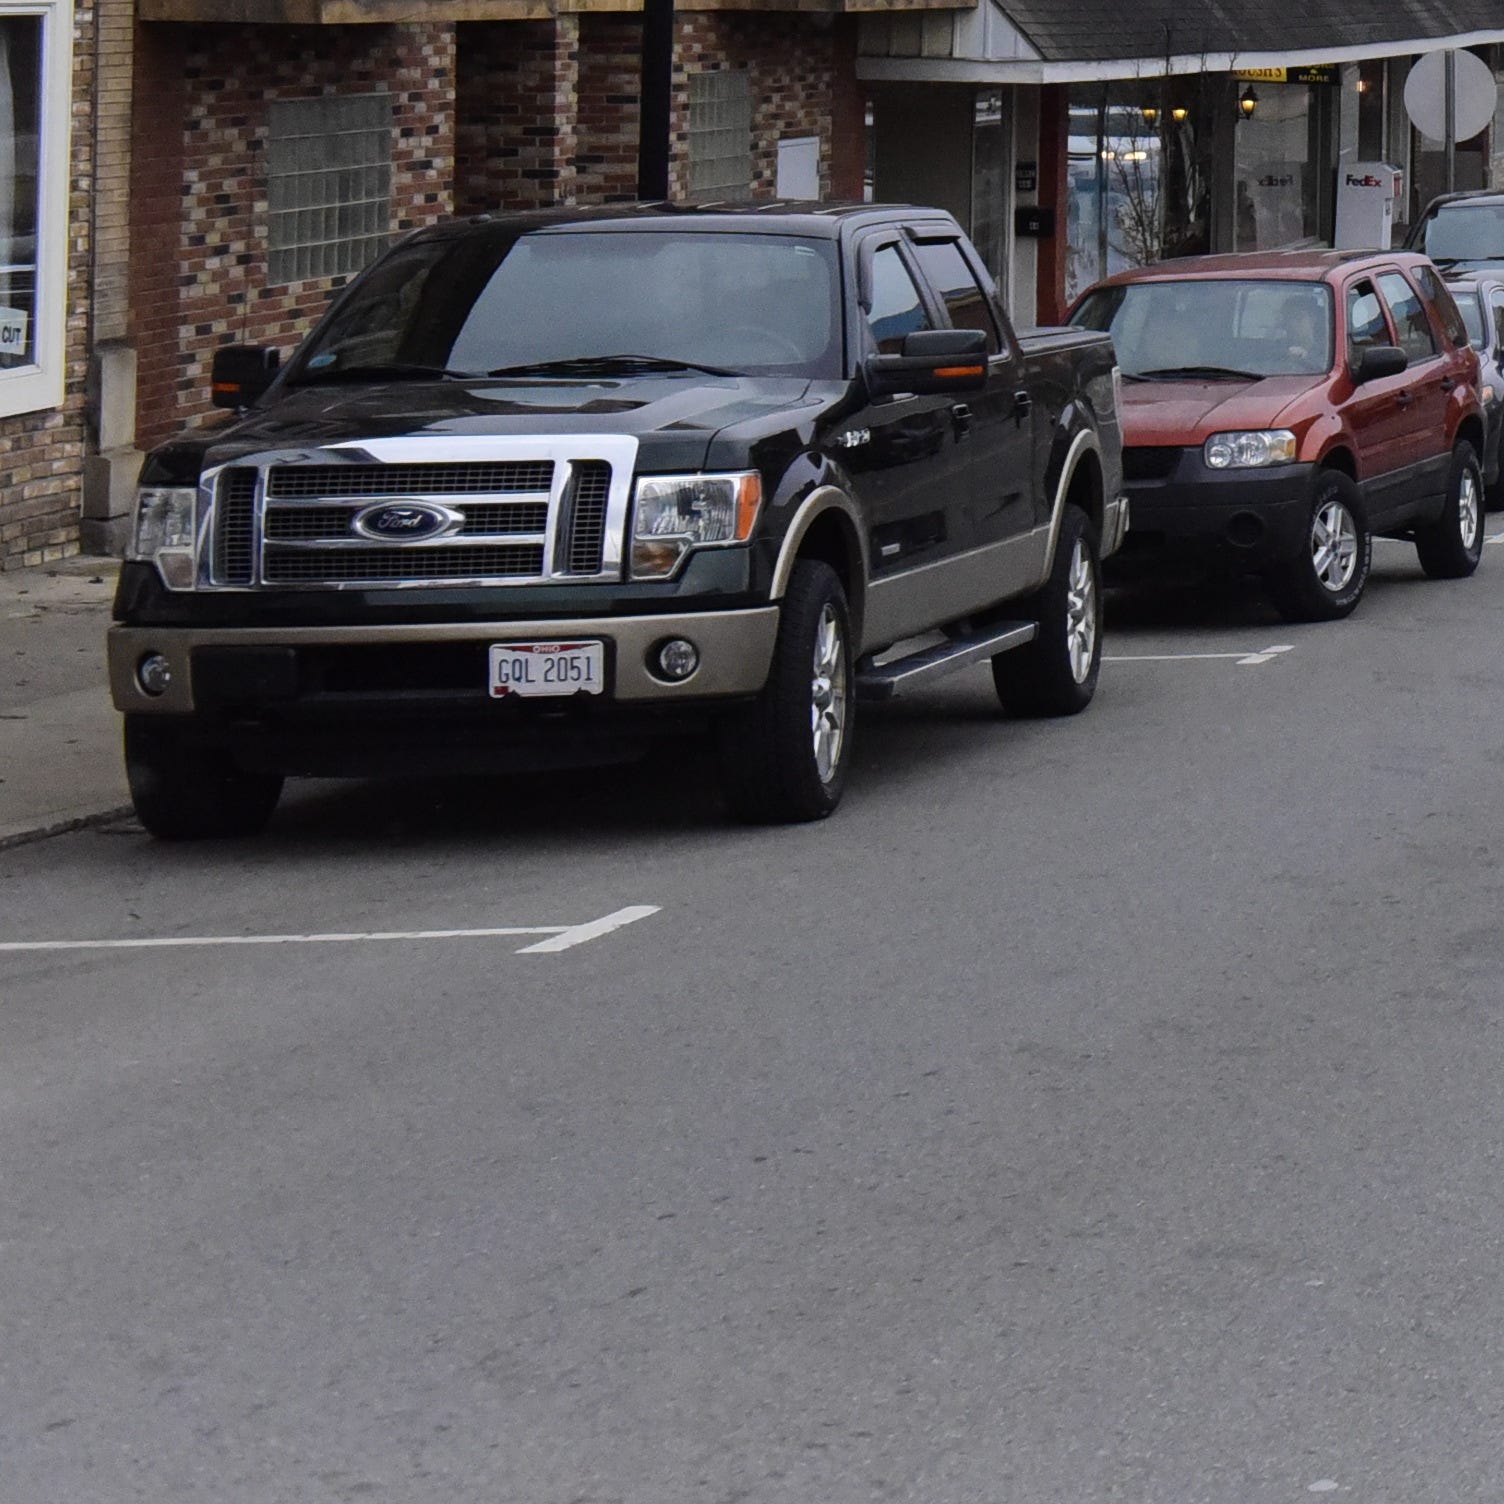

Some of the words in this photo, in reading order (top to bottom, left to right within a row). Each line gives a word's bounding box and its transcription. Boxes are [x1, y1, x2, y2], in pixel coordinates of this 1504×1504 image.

[1346, 174, 1381, 187] FedEx
[377, 510, 423, 528] Ford
[532, 645, 561, 653] OHIO
[498, 658, 536, 684] GQL
[543, 656, 593, 683] 2051
